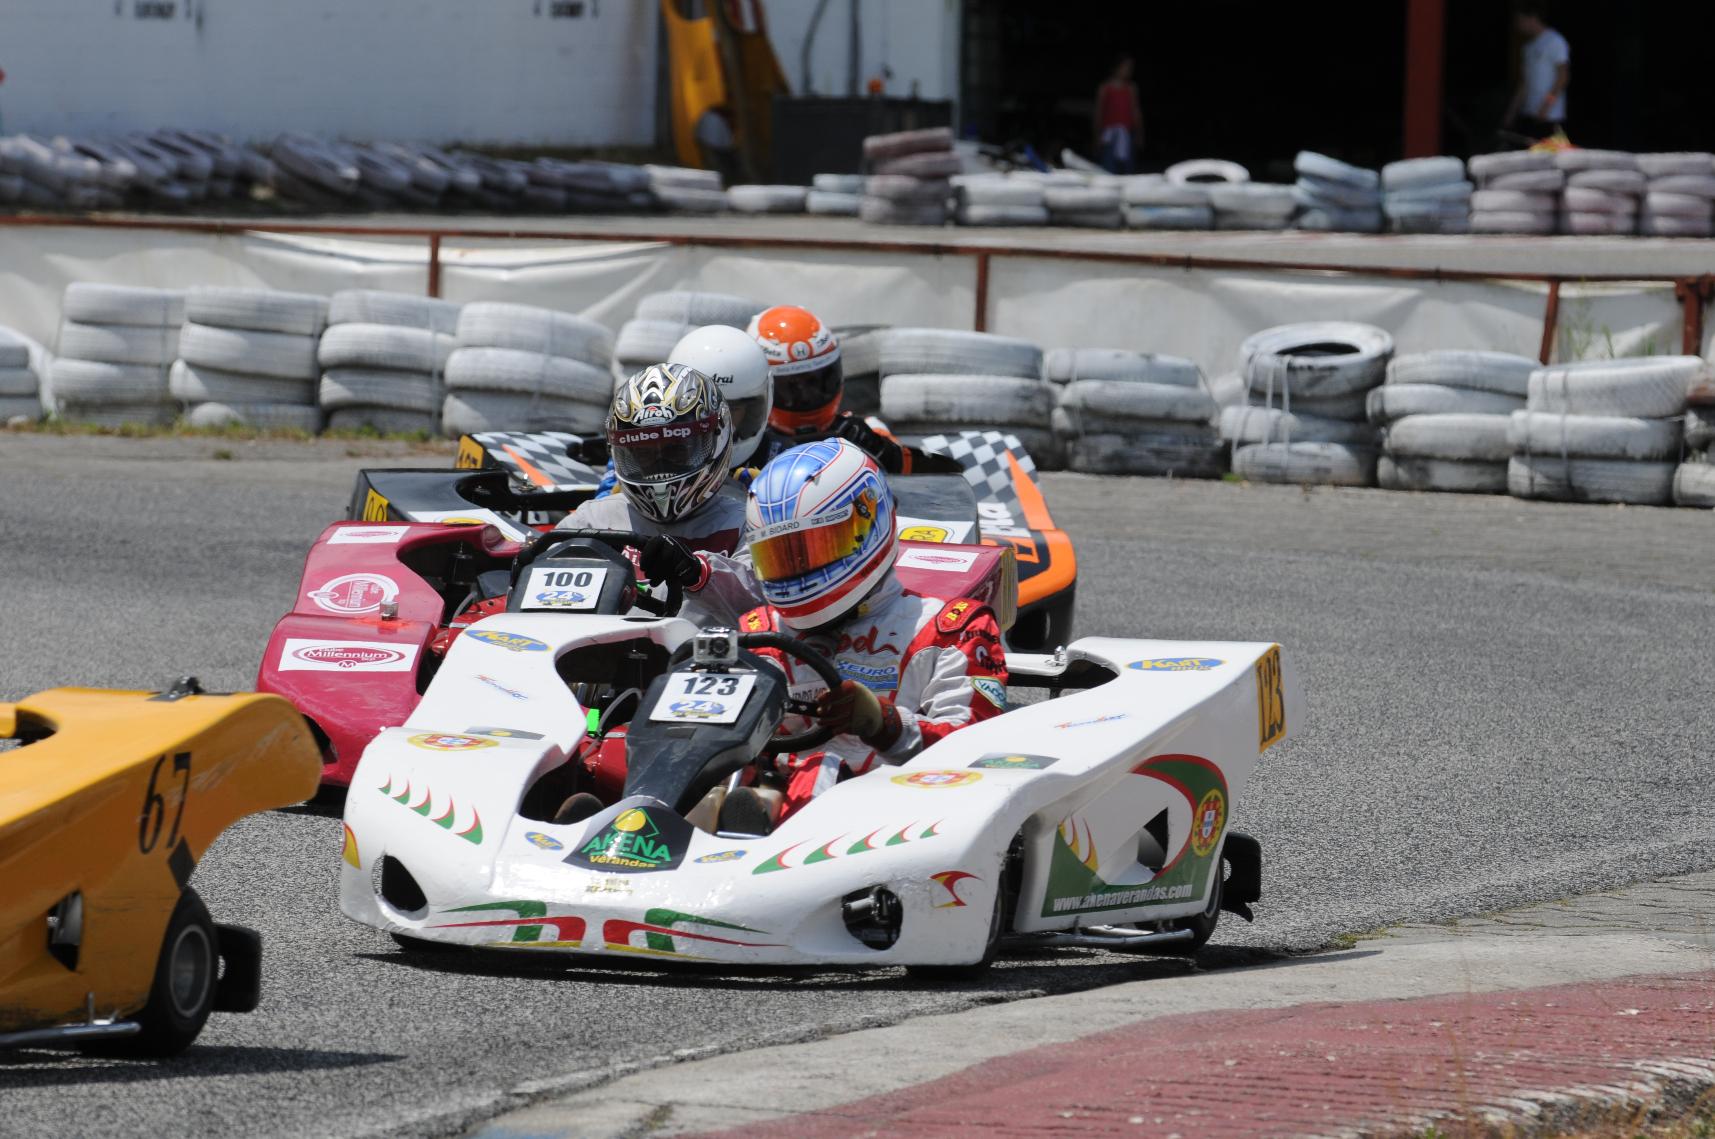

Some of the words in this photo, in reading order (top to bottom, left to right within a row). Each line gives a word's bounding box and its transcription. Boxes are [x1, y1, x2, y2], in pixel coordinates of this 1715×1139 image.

[619, 431, 660, 445] clube
[662, 427, 692, 440] bcp
[543, 571, 593, 588] 100
[306, 649, 388, 660] Millennium
[683, 676, 740, 696] 123
[1257, 649, 1285, 746] 123
[138, 751, 192, 855] 67
[581, 832, 673, 862] AKENA
